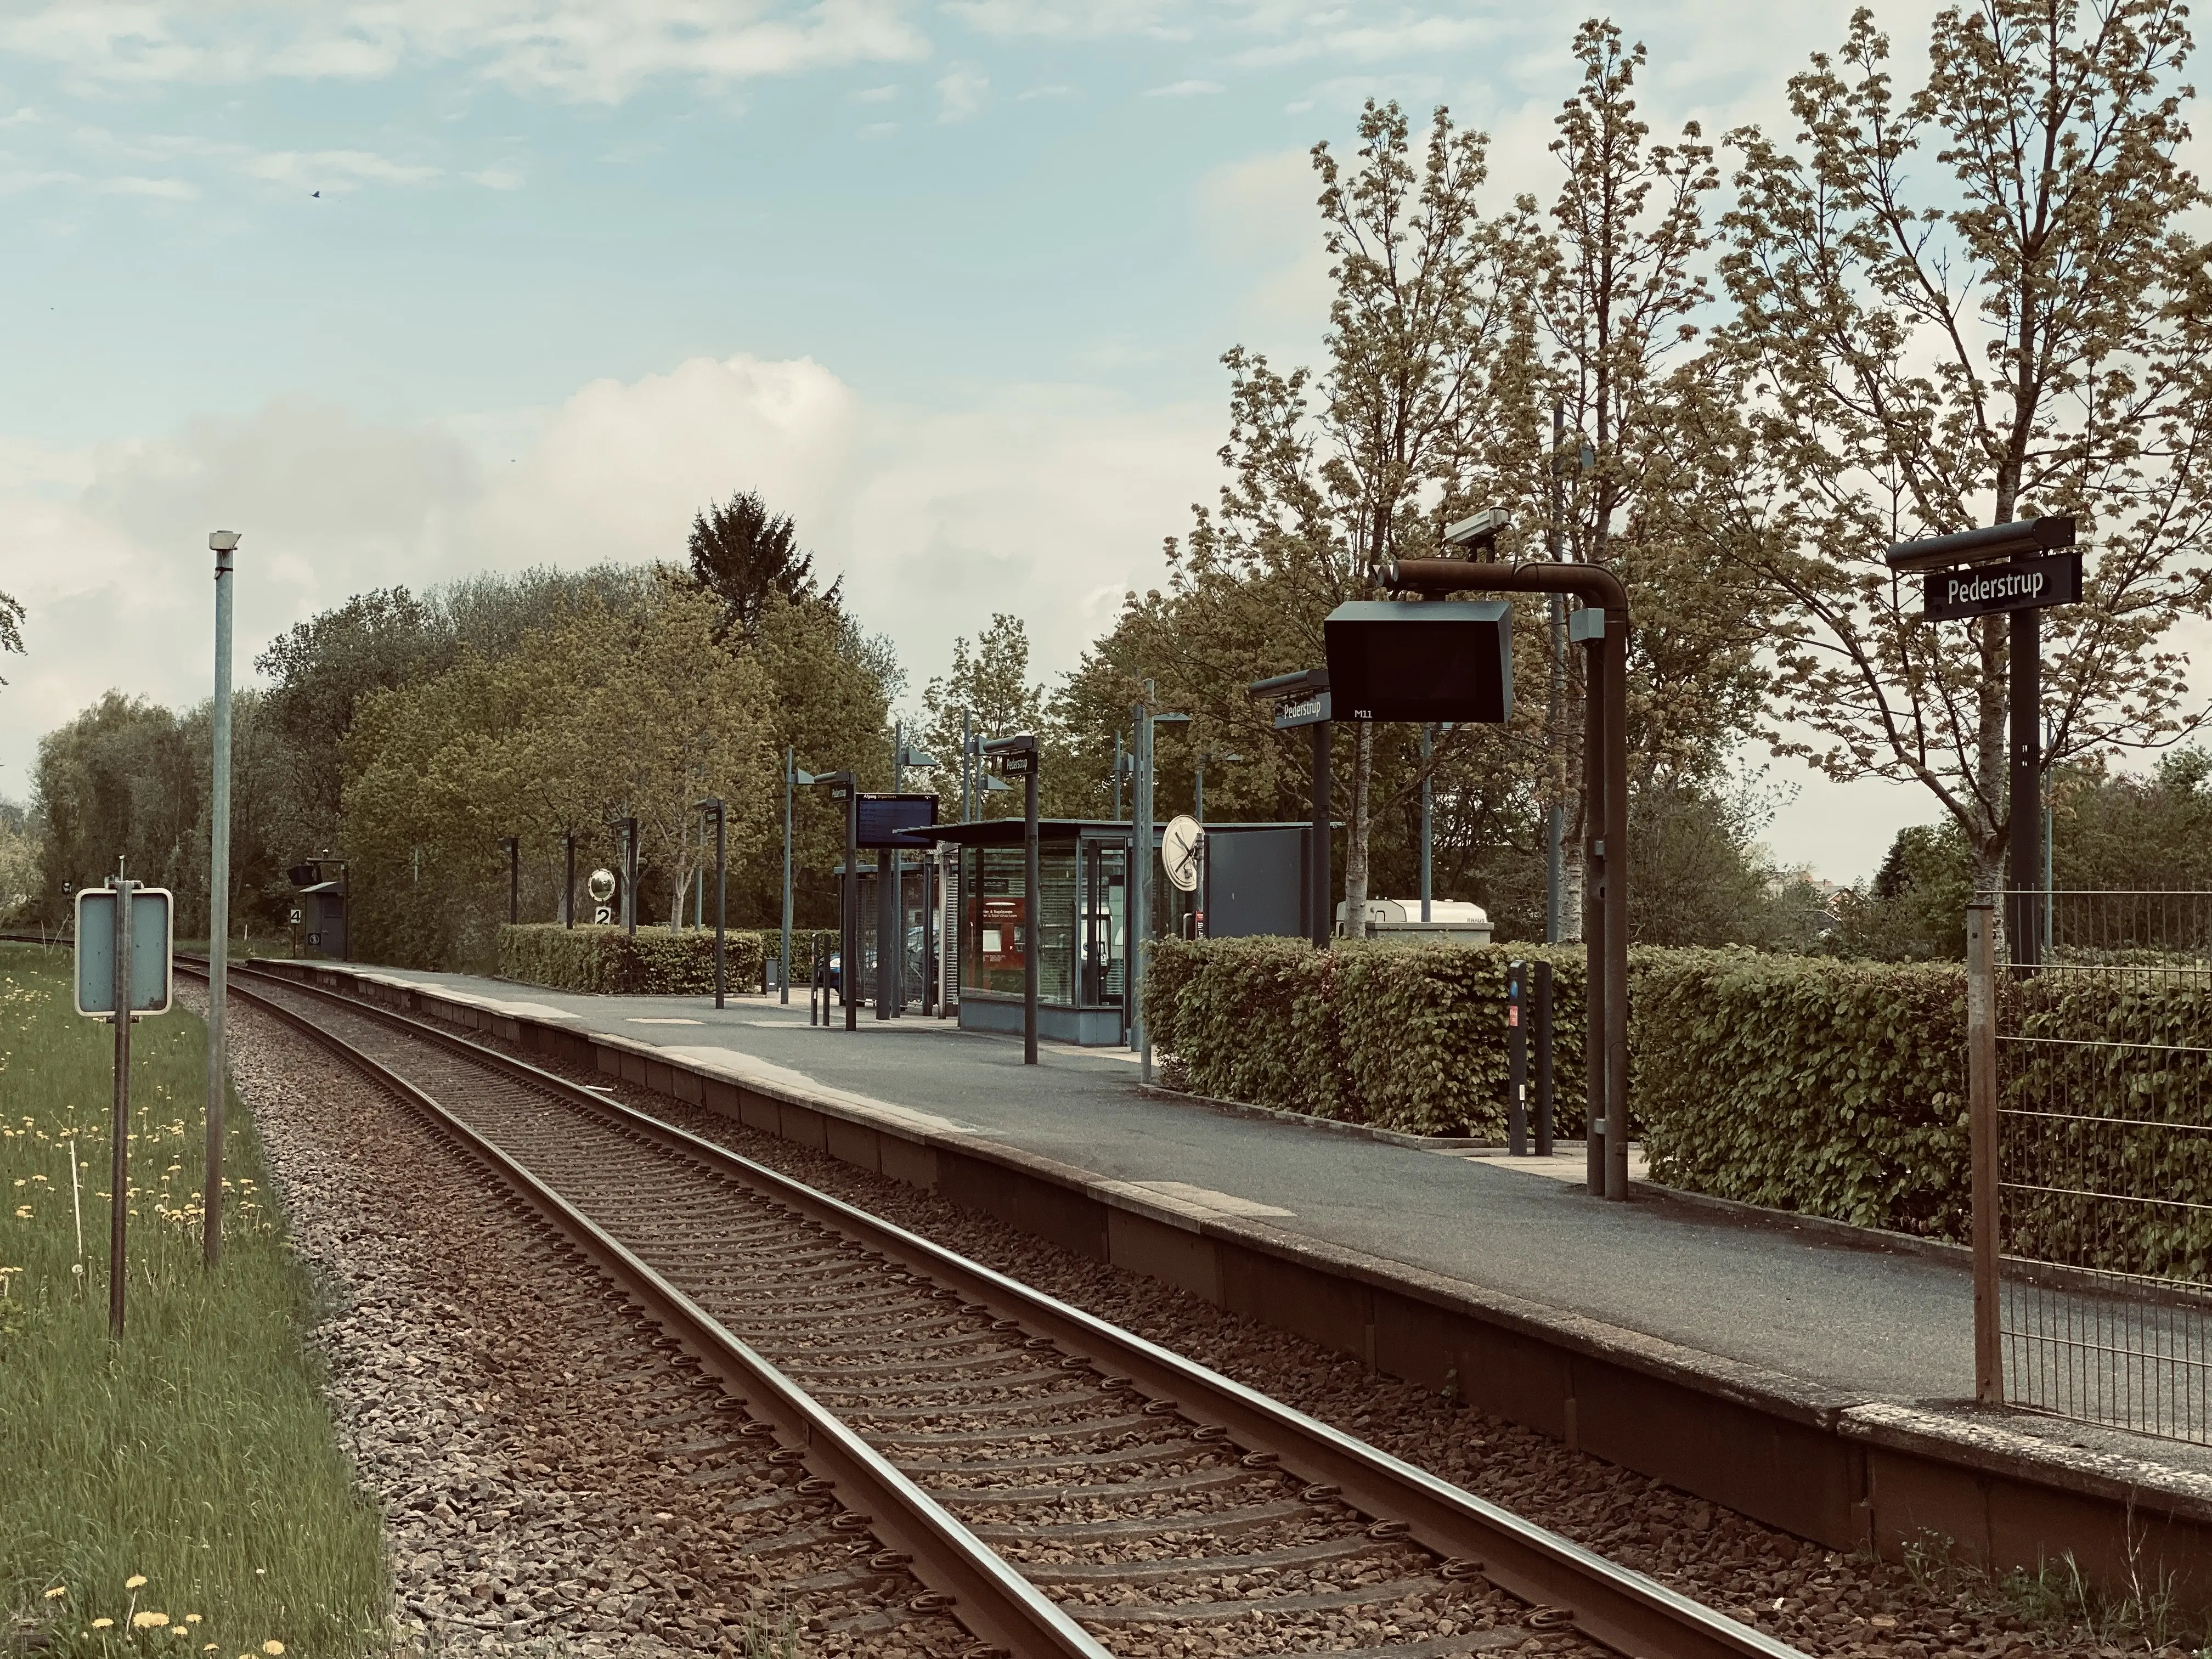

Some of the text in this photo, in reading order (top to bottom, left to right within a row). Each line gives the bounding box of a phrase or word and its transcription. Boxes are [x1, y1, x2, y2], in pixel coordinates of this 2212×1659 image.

[1948, 571, 2044, 604] Pederstrup
[1284, 701, 1321, 720] Pederstrup
[1355, 710, 1373, 719] M11
[291, 910, 301, 922] 4
[596, 909, 610, 924] 2
